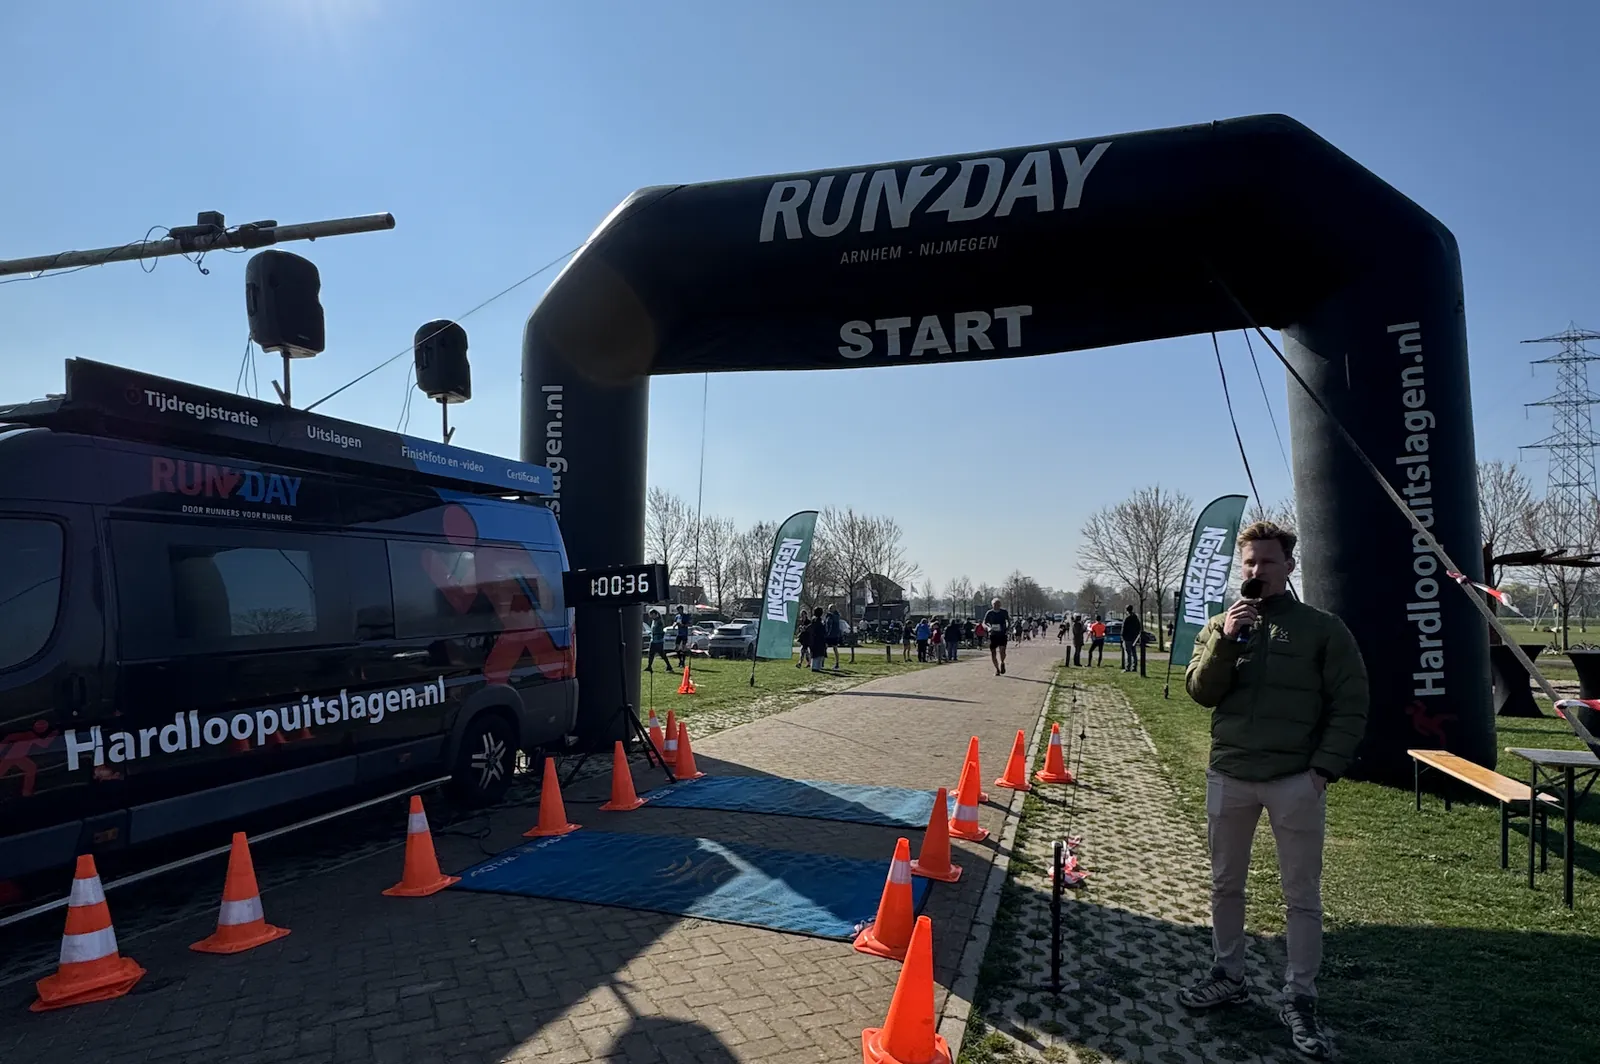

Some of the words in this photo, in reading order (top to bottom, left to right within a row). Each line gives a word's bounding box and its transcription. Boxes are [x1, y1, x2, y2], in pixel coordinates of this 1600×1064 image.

[759, 141, 1113, 243] RUN2DAY
[840, 246, 902, 265] ARNHEM
[919, 235, 999, 257] NIJMEGEN
[837, 304, 1033, 360] START
[144, 389, 259, 428] Tijdregistratie
[306, 424, 362, 449] Uitslagen
[401, 445, 447, 465] Finishfoto
[447, 457, 459, 468] en
[459, 459, 485, 473] -video
[151, 456, 302, 507] RUN2DAY
[506, 468, 541, 485] Certificaat
[182, 504, 204, 514] DOOR
[205, 507, 240, 518] RUNNERS
[242, 510, 261, 520] VOOR
[262, 513, 293, 522] RUNNERS
[1386, 320, 1447, 697] Hardloopuitslagen.nl
[591, 573, 649, 597] 1:00:36
[766, 537, 804, 624] LINGEZEGEN
[782, 559, 807, 603] RUN
[1183, 525, 1228, 627] LINGEZEGEN
[1204, 553, 1232, 604] RUN
[64, 674, 447, 772] Hardloopuitslagen.nl
